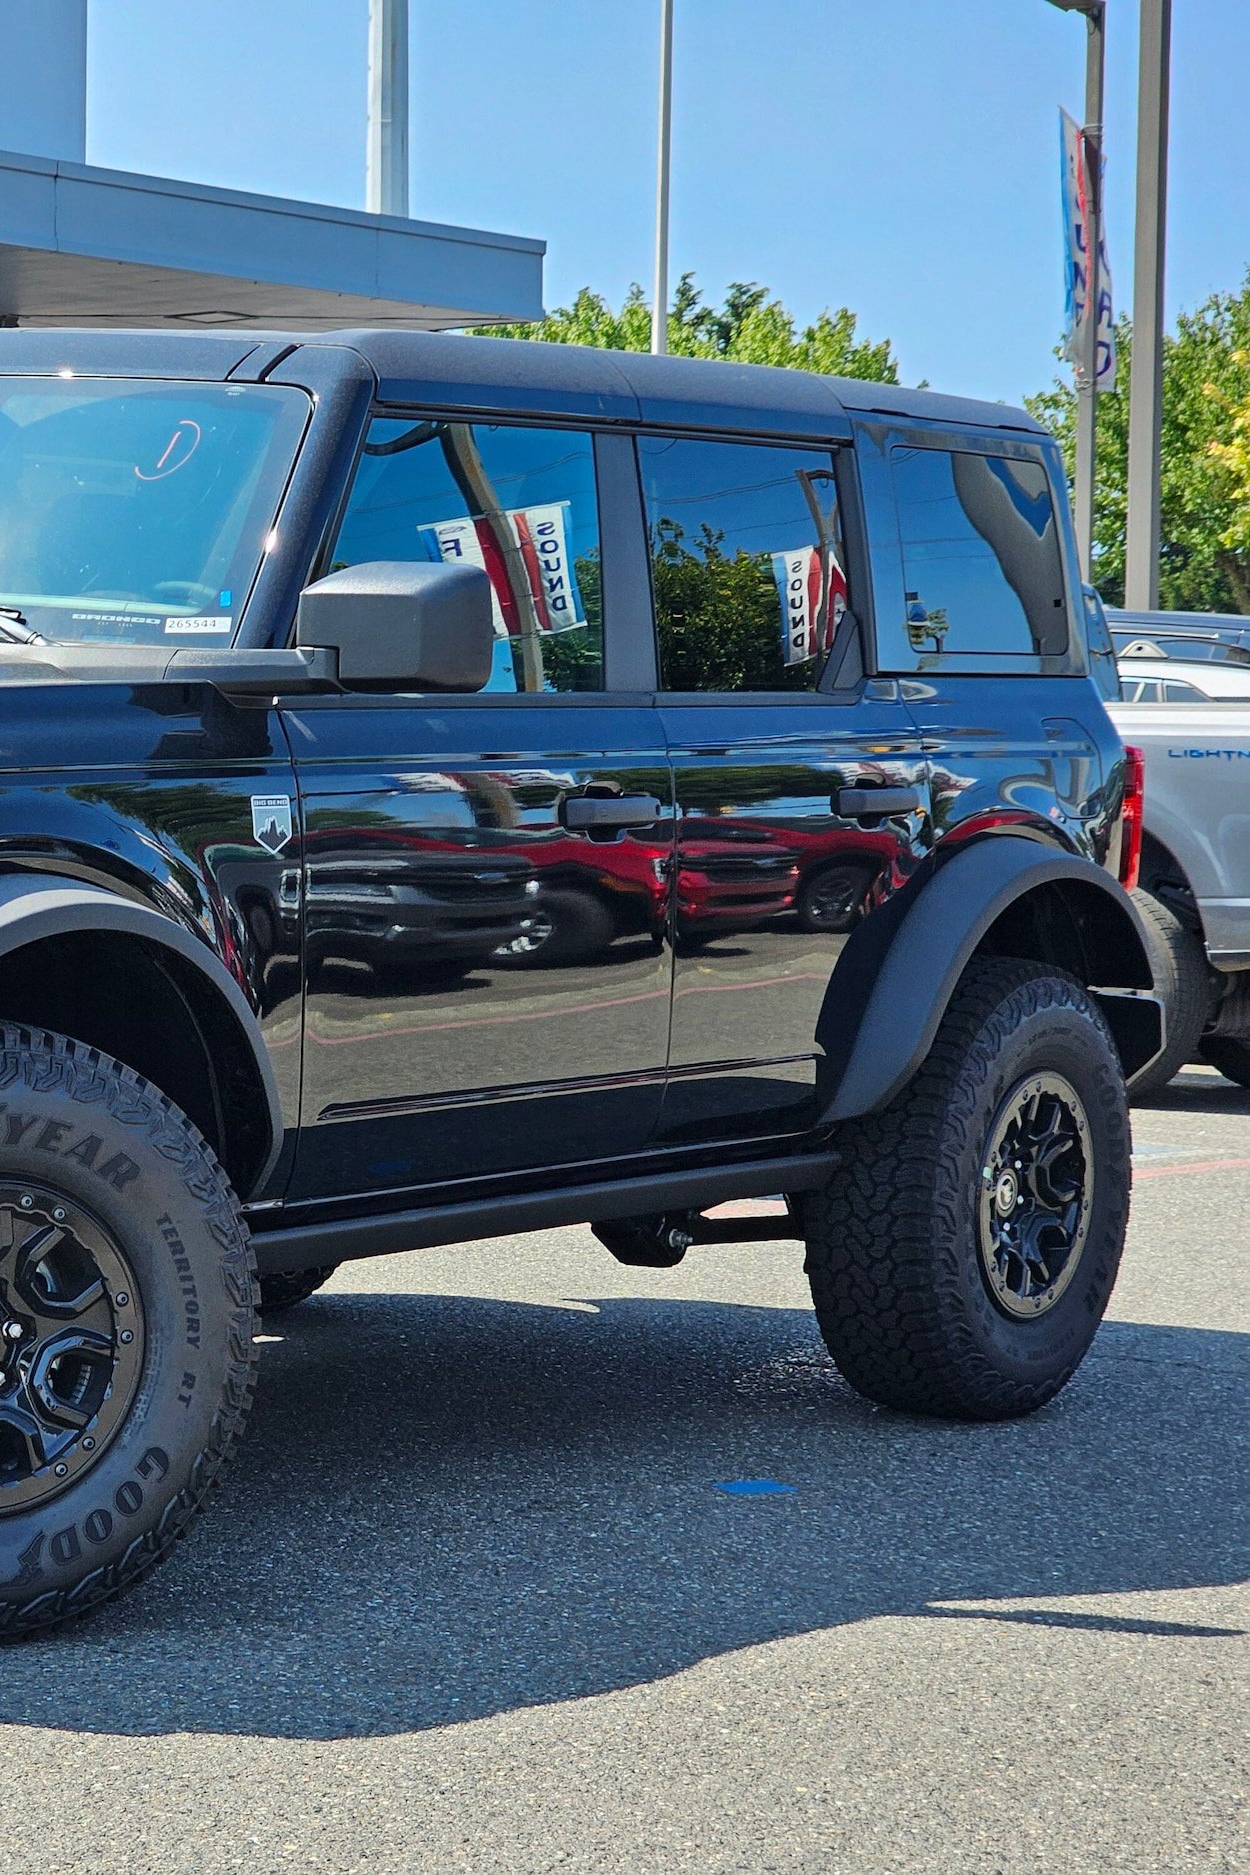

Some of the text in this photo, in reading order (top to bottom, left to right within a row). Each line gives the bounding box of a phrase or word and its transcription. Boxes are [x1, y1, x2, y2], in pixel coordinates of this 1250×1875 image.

[168, 619, 217, 629] 265544
[155, 1211, 201, 1350] TERRITORY
[177, 1371, 198, 1410] RT
